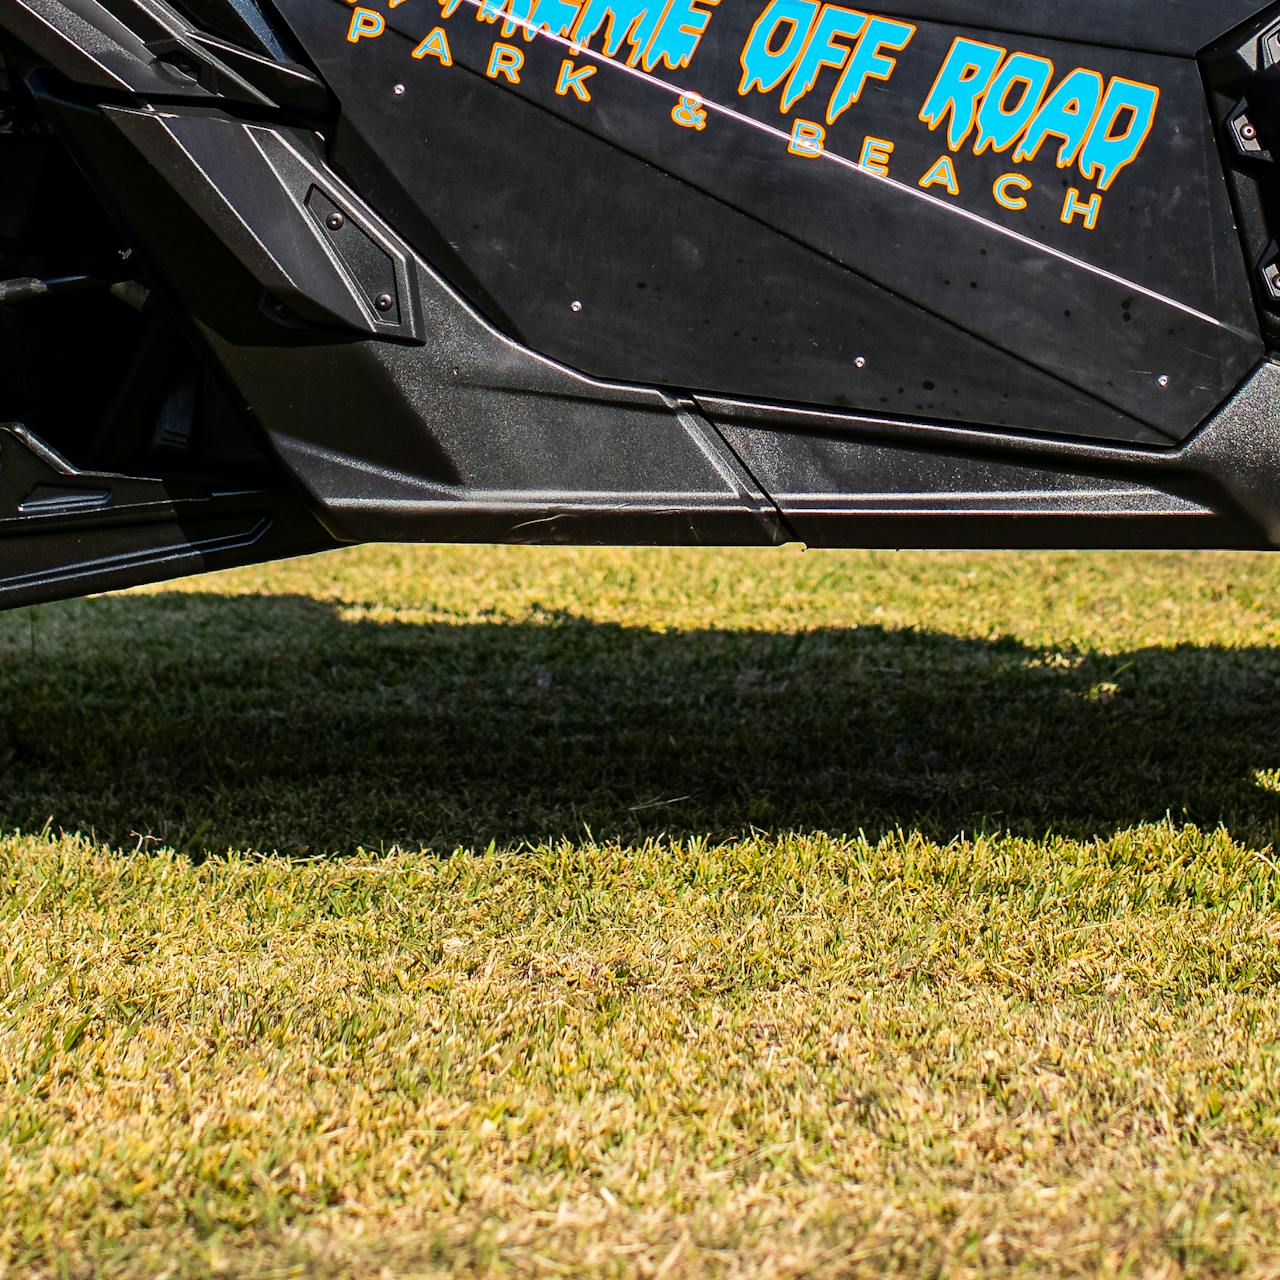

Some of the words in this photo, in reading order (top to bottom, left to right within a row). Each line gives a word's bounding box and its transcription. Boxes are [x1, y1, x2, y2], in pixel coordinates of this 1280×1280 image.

[347, 5, 594, 103] PARK
[671, 89, 708, 131] &
[787, 116, 1101, 230] BEACH
[921, 35, 1160, 192] ROAD
